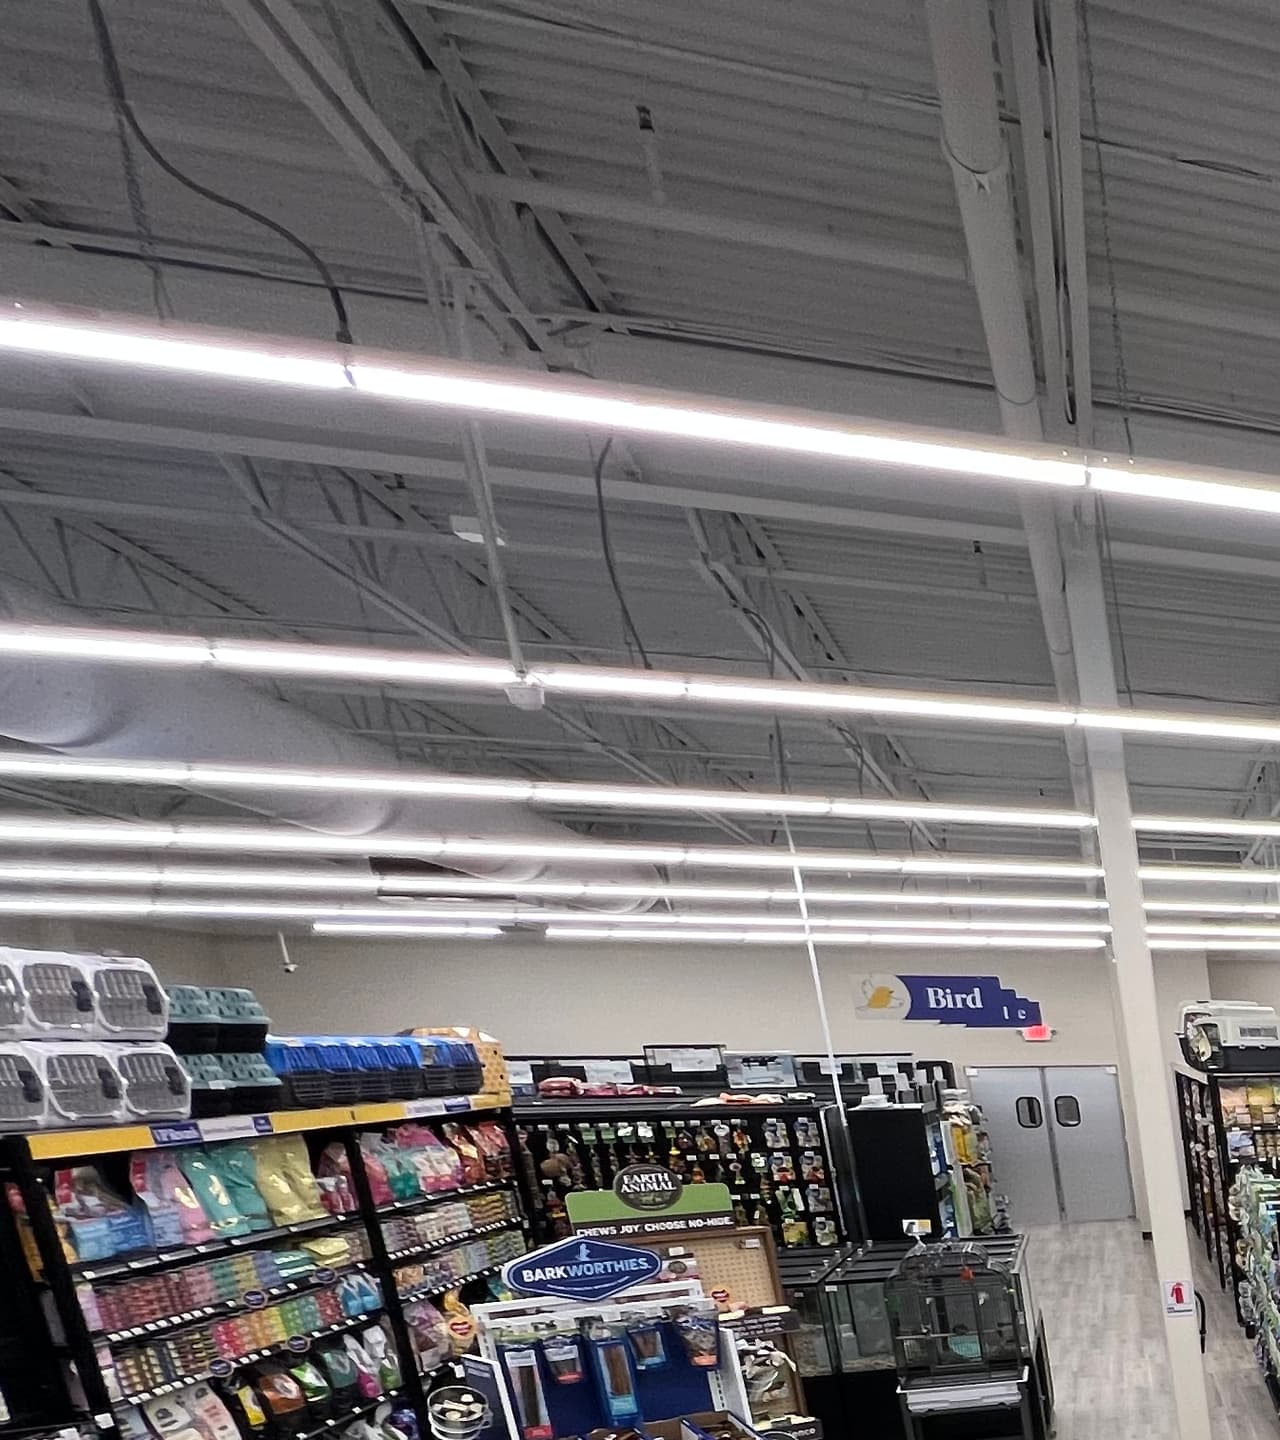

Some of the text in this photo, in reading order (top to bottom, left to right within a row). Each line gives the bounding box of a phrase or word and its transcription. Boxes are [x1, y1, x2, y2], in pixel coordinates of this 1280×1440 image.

[926, 986, 983, 1009] Bird
[620, 1180, 677, 1193] ANIMAL
[623, 1171, 669, 1185] EARTH
[576, 1224, 617, 1238] CHEWS
[644, 1220, 686, 1233] CHOOSE
[522, 1256, 651, 1283] BARKWORTHIES
